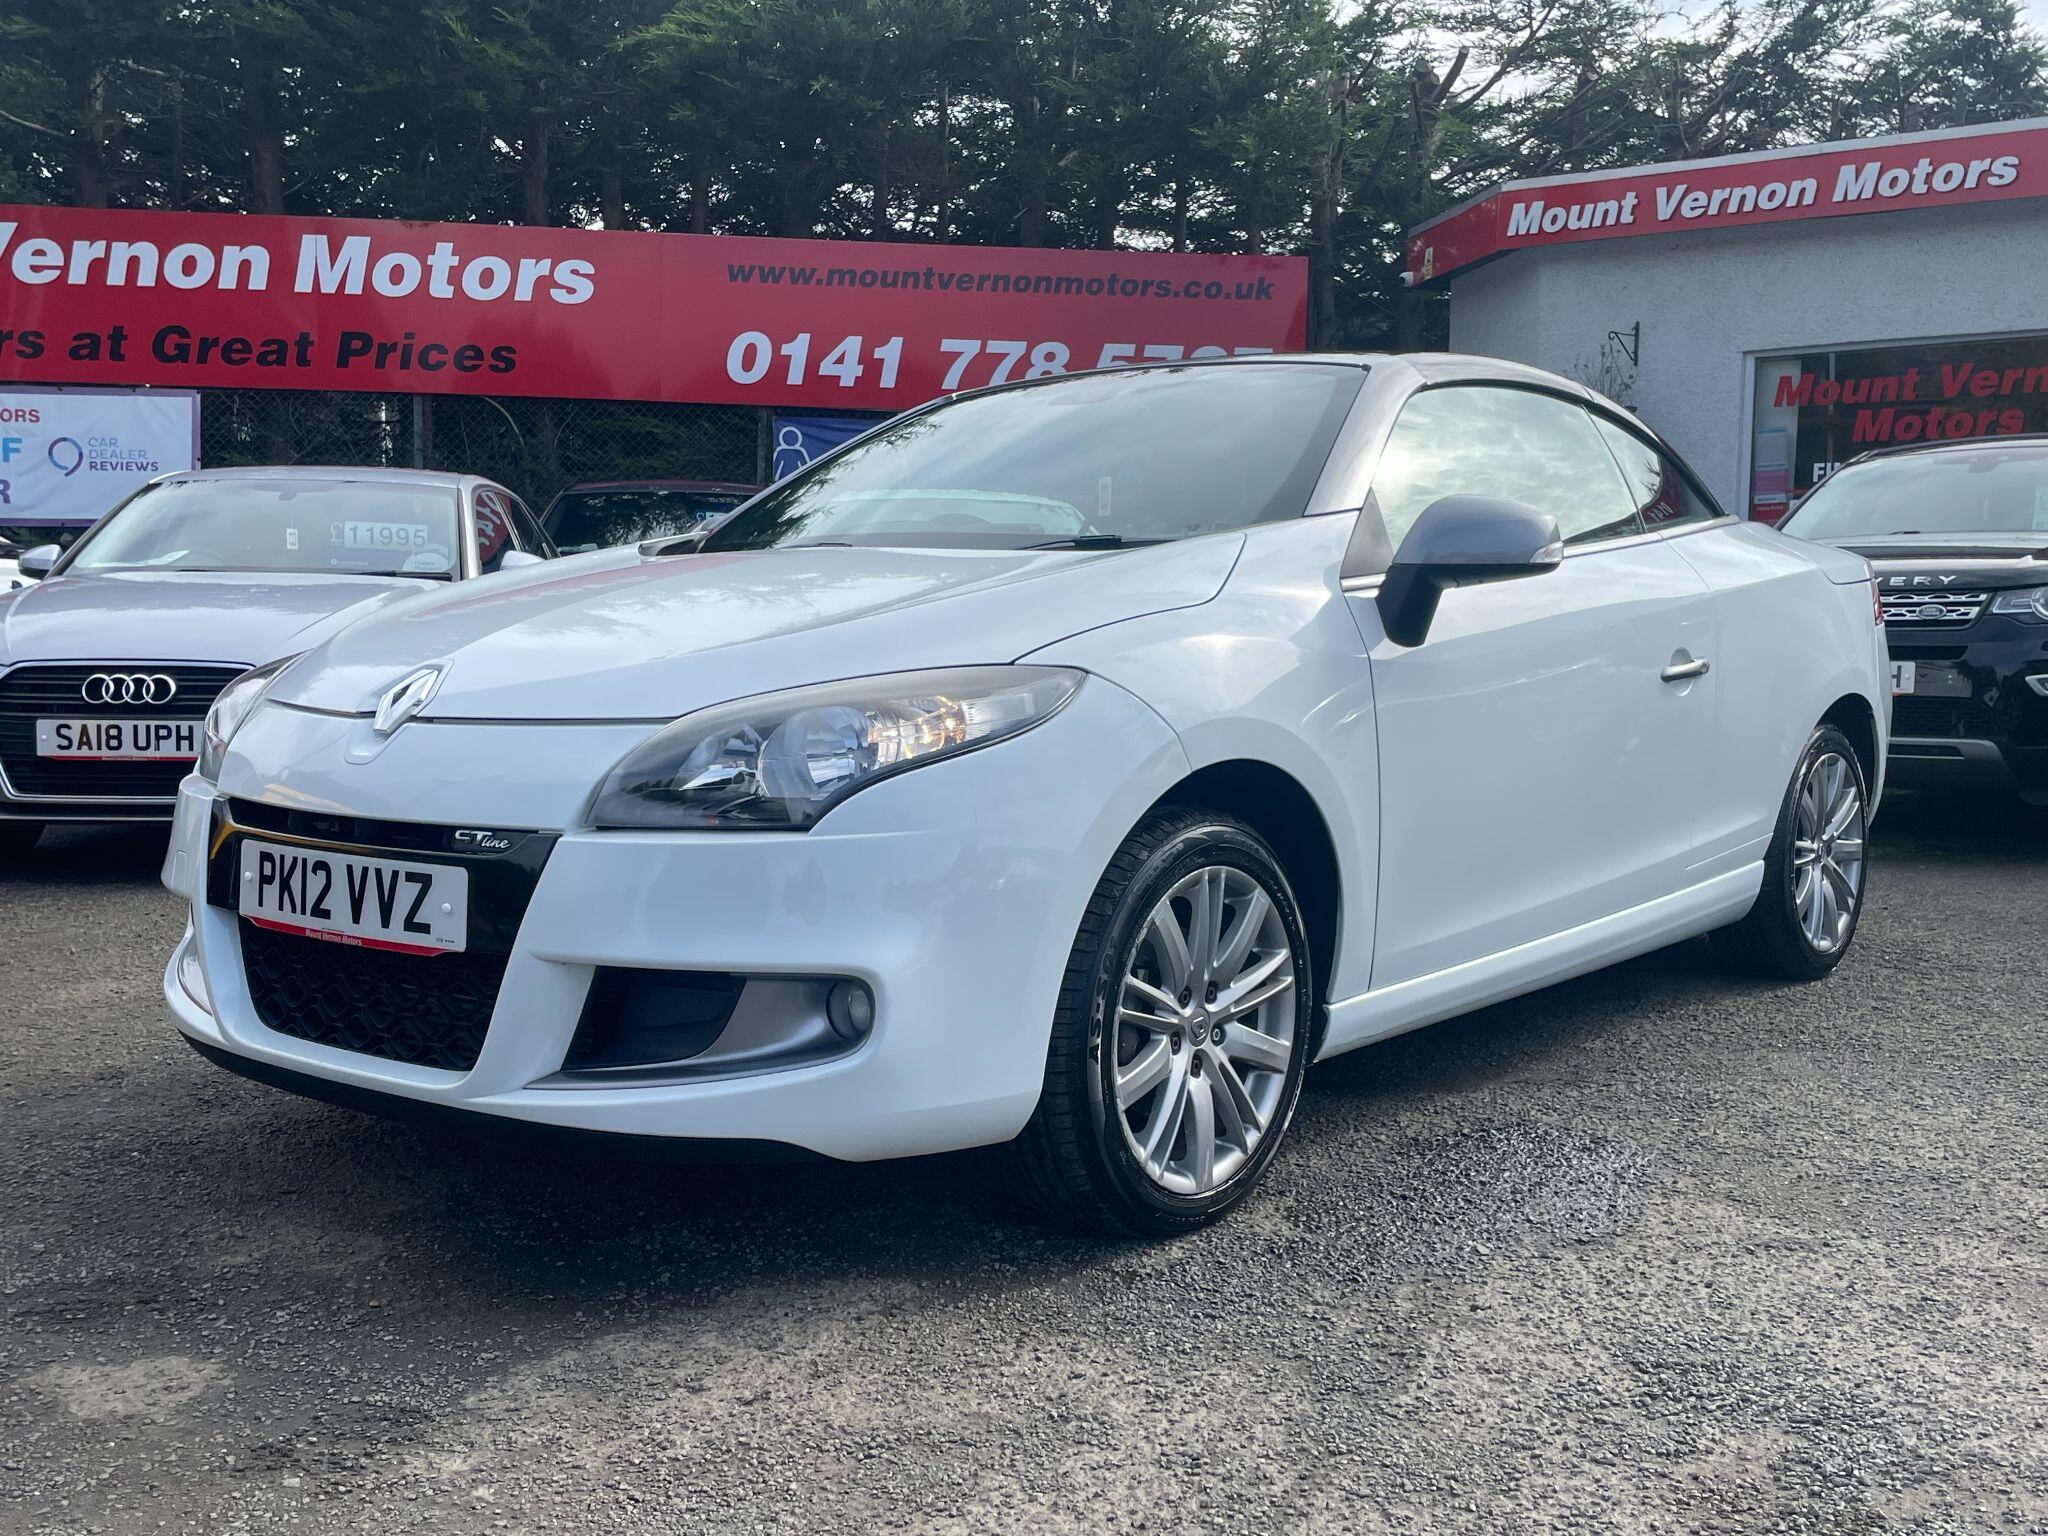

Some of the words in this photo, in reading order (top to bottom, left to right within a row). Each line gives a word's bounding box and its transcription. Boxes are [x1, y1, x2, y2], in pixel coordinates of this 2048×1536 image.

[1506, 190, 1638, 238] Mount
[1654, 176, 1818, 222] Vernon
[1831, 154, 2020, 203] Motors
[293, 233, 596, 304] Motors
[727, 263, 1275, 302] www.mountvernonmotors.co.uk
[68, 325, 128, 362] at
[151, 325, 315, 368] Great
[336, 331, 519, 374] Prices
[726, 330, 904, 390] 0141
[940, 338, 1070, 390] 778
[1773, 367, 1921, 408] Mount
[88, 437, 119, 448] CAR
[1852, 405, 2025, 444] Motors
[89, 450, 148, 460] DEALER
[89, 461, 159, 472] REVIEWS
[55, 723, 123, 751] SA18
[132, 724, 195, 752] UPH
[257, 850, 333, 921] PK12
[345, 863, 434, 935] VVZ
